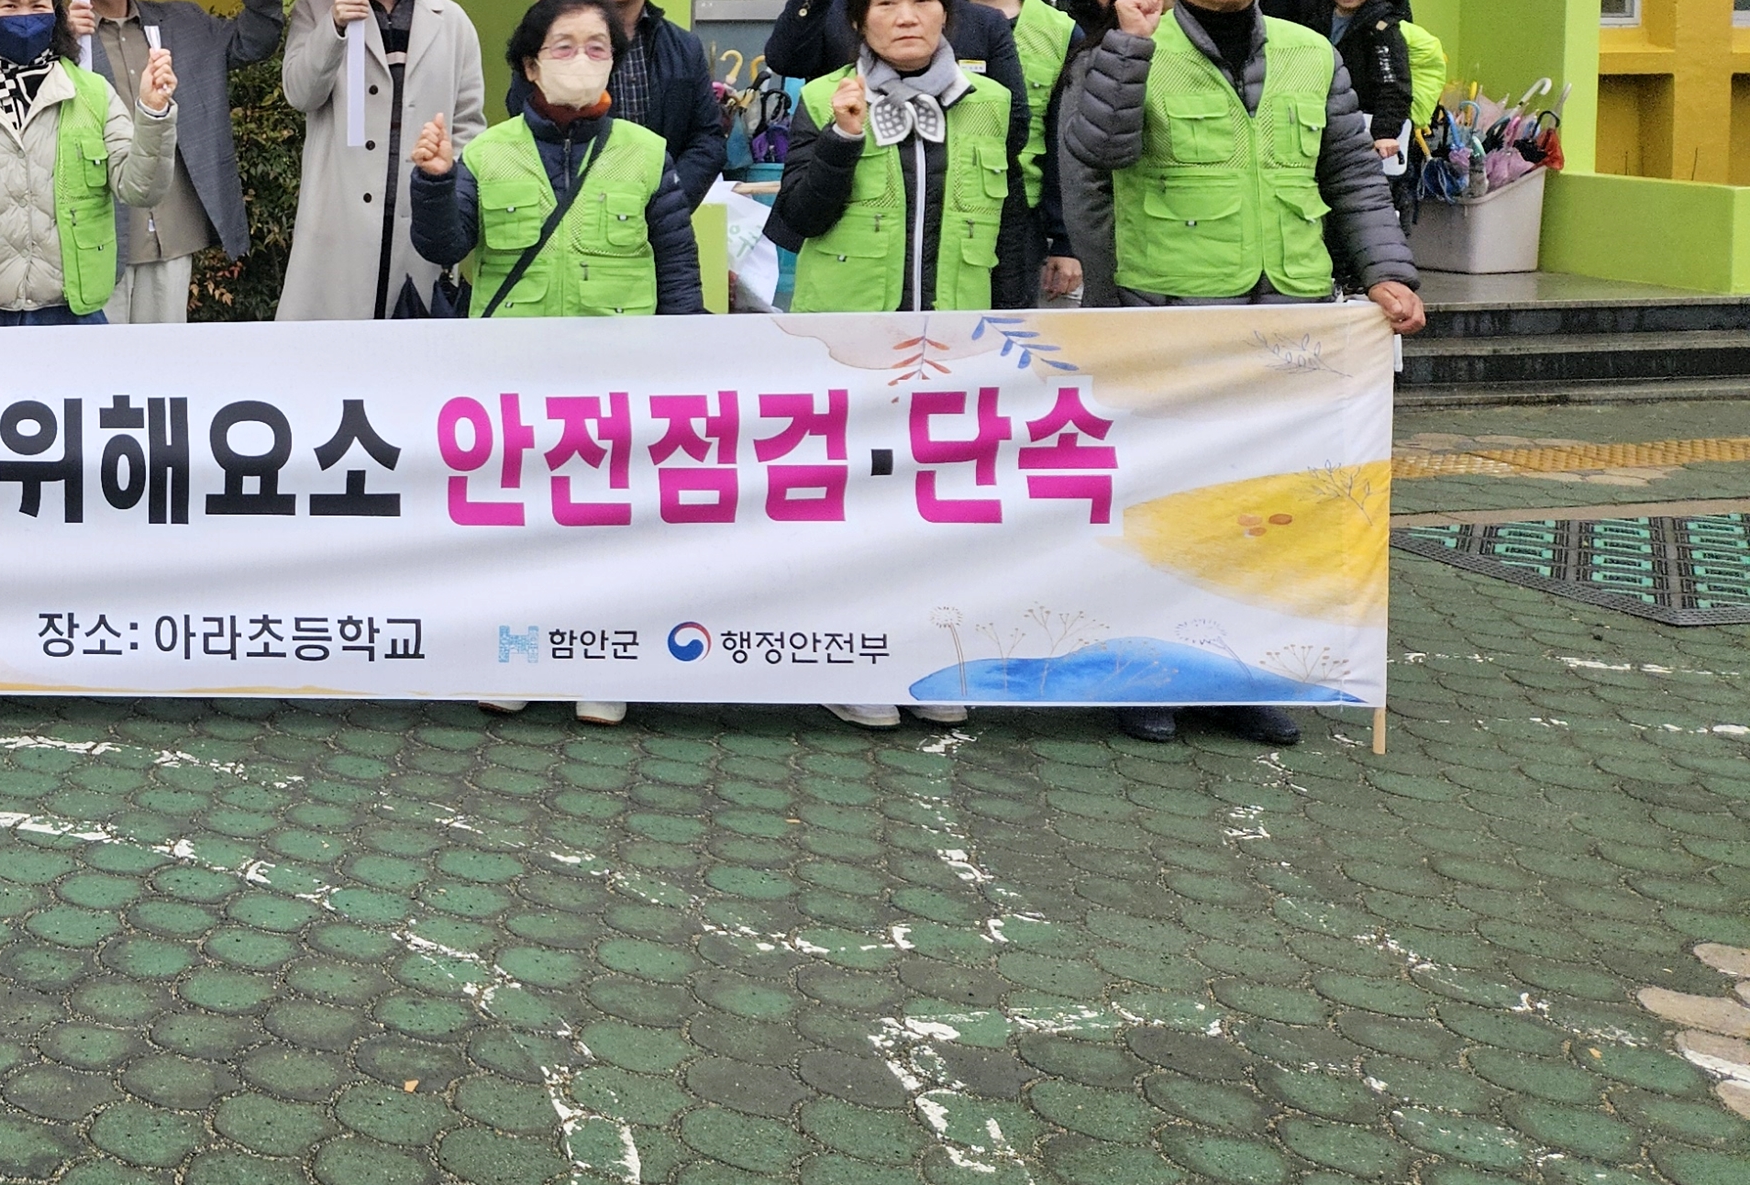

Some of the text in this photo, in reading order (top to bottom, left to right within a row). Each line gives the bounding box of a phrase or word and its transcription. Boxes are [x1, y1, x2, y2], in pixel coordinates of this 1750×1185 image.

[154, 614, 426, 663] 아라초등학교
[548, 629, 641, 661] 함안군
[720, 630, 891, 665] 행정안전부
